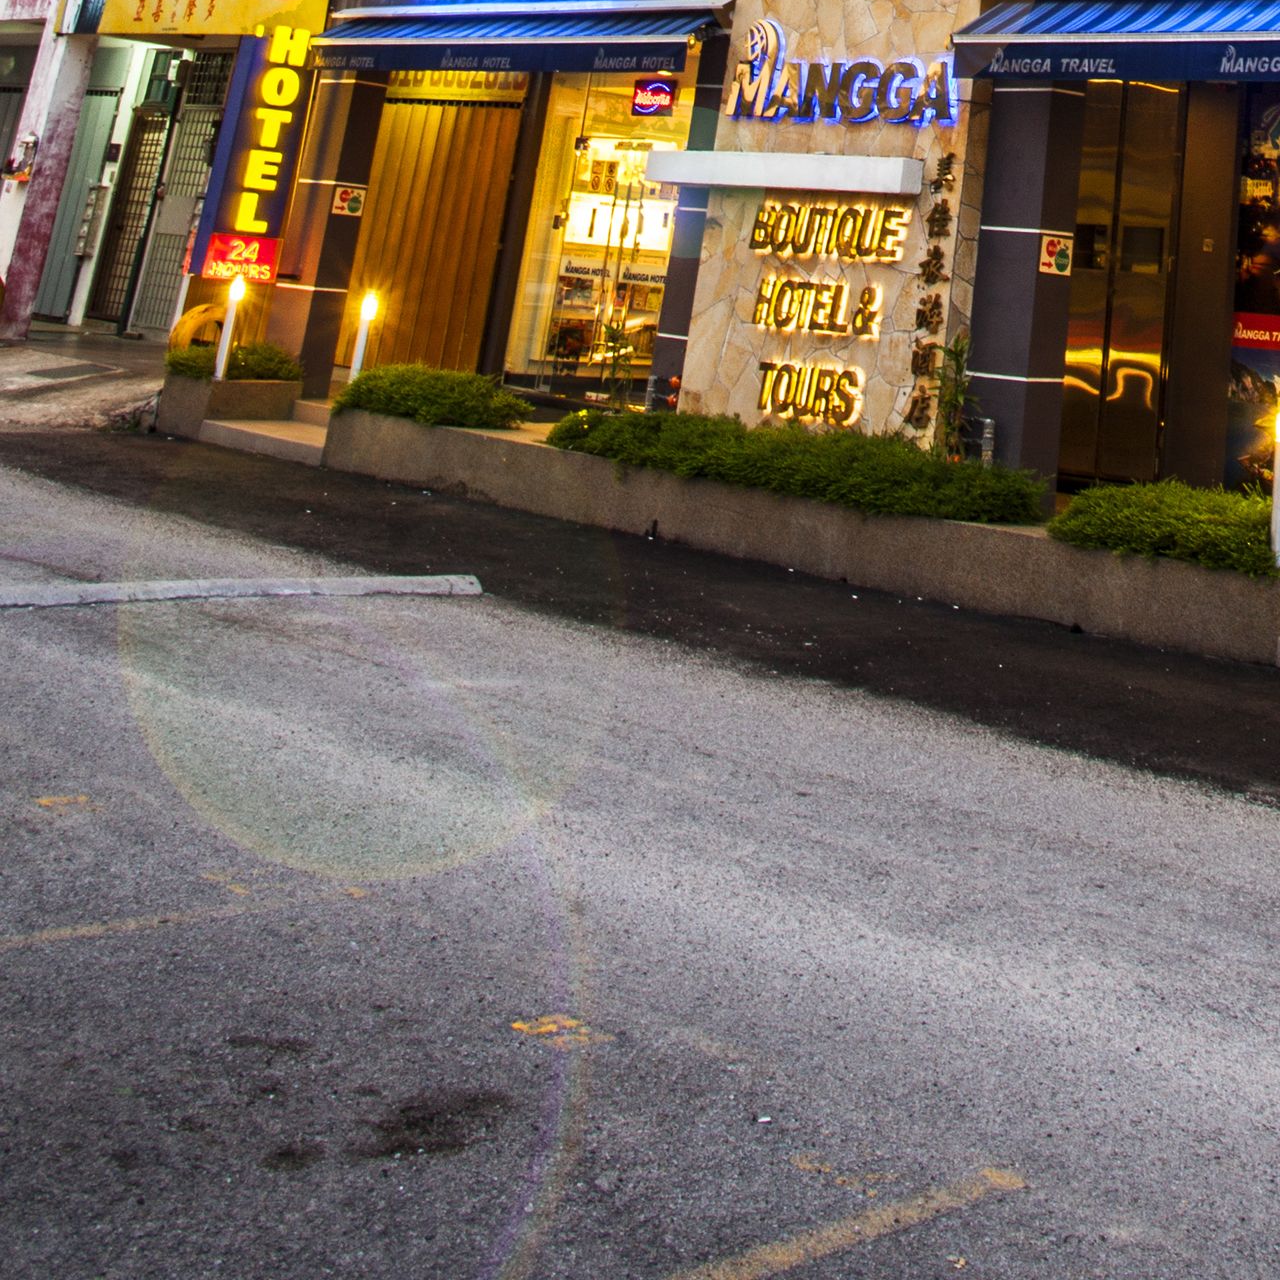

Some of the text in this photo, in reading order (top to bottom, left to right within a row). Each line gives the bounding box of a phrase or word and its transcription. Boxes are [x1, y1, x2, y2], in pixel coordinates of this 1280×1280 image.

[351, 56, 375, 68] HOTEL
[440, 48, 511, 69] MANGGA HOTEL
[594, 48, 675, 70] MANGGA HOTEL
[989, 47, 1116, 74] MANGGA TRAVEL
[726, 19, 954, 122] MANGGA
[233, 25, 311, 234] HOTEL
[750, 203, 908, 260] BOUTIQUE
[229, 240, 261, 263] 24
[208, 262, 271, 281] HOURS
[565, 260, 590, 276] MANGGA
[623, 266, 648, 282] MANGGA
[753, 277, 881, 336] HOTEL &
[1234, 322, 1271, 340] MANGGA
[757, 360, 862, 428] TOURS
